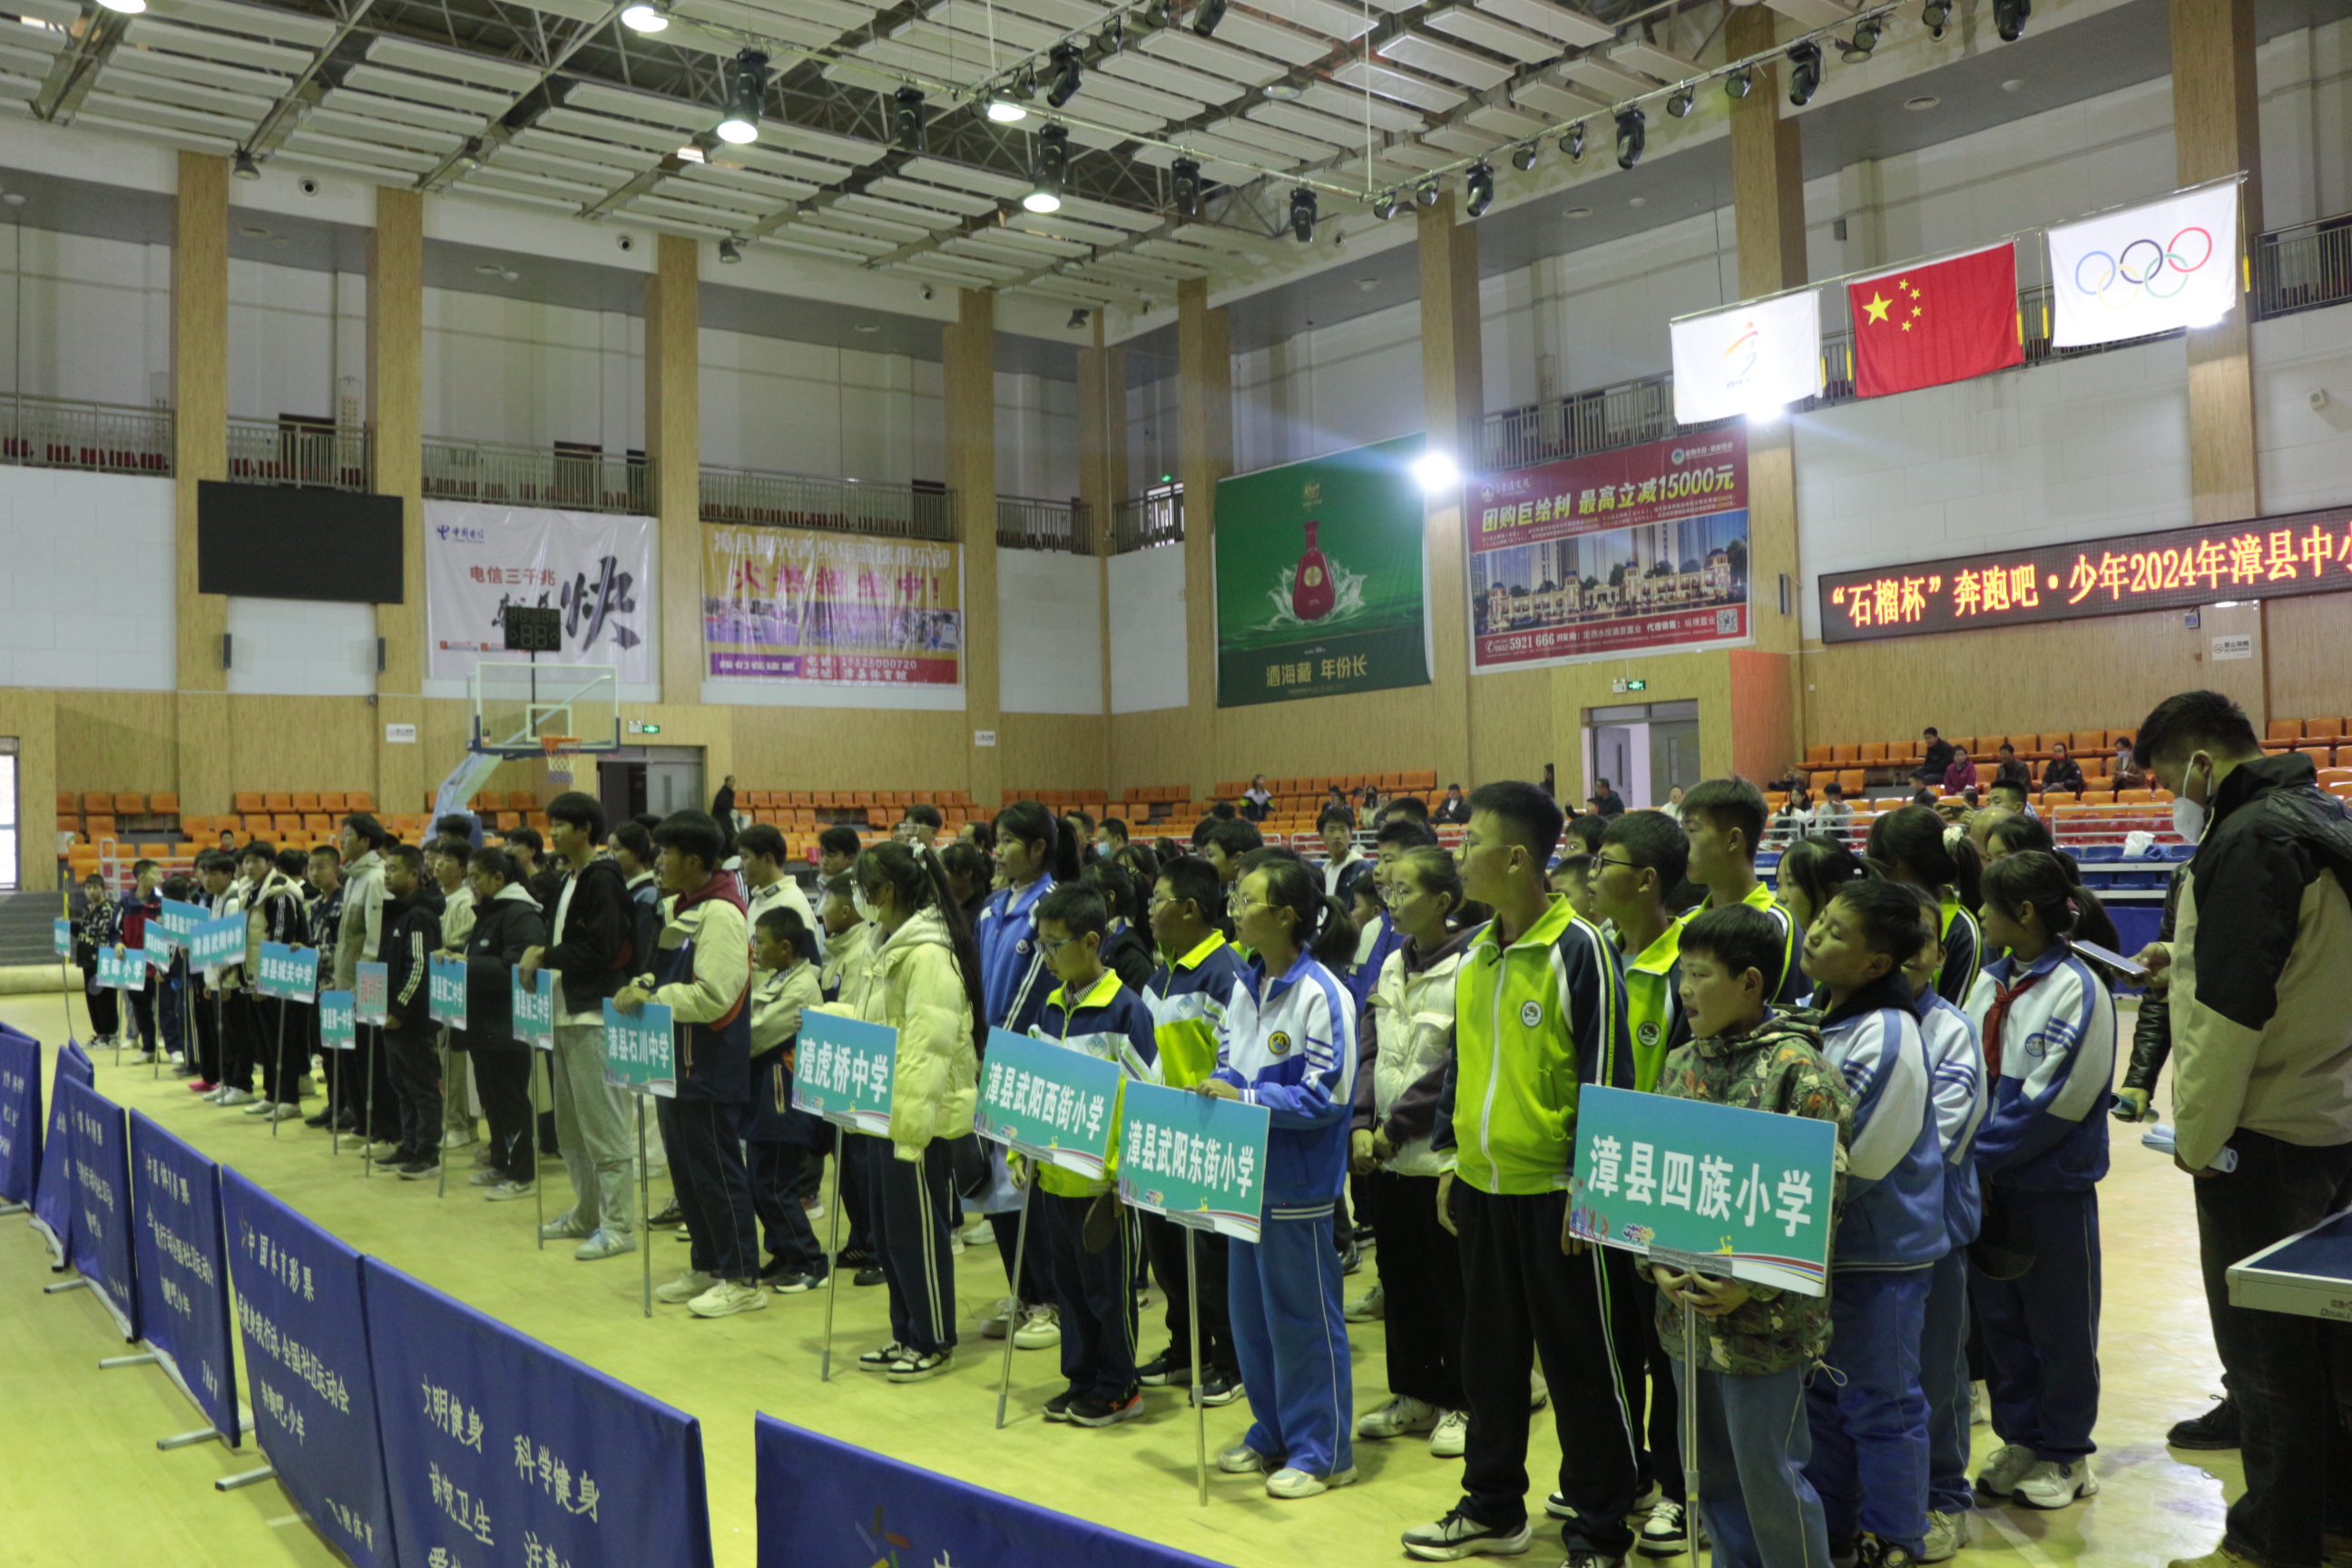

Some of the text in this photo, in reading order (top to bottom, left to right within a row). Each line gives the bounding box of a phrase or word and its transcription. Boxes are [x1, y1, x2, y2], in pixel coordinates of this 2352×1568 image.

[1483, 493, 1571, 533] 团购巨给利
[1579, 464, 1735, 515] 最高立减15000元
[470, 565, 555, 586] 电信三千兆
[560, 554, 641, 654] 快
[1267, 653, 1368, 688] 酒海藏 年份长
[1509, 635, 1533, 651] 5921
[1535, 632, 1554, 647] 666
[260, 957, 312, 986] 漳县城关中学
[608, 1026, 670, 1070] 漳县石川中学
[799, 1037, 889, 1104] 殪虎桥中学
[985, 1062, 1105, 1141] 漳县武阳西街小学
[1126, 1120, 1254, 1199] 漳县武阳东街小学
[1587, 1133, 1813, 1238] 漳县四族小学
[248, 1225, 314, 1303] 中国体育彩票
[421, 1373, 600, 1524] 文明健身 科学健身
[427, 1461, 495, 1547] 讲究卫生
